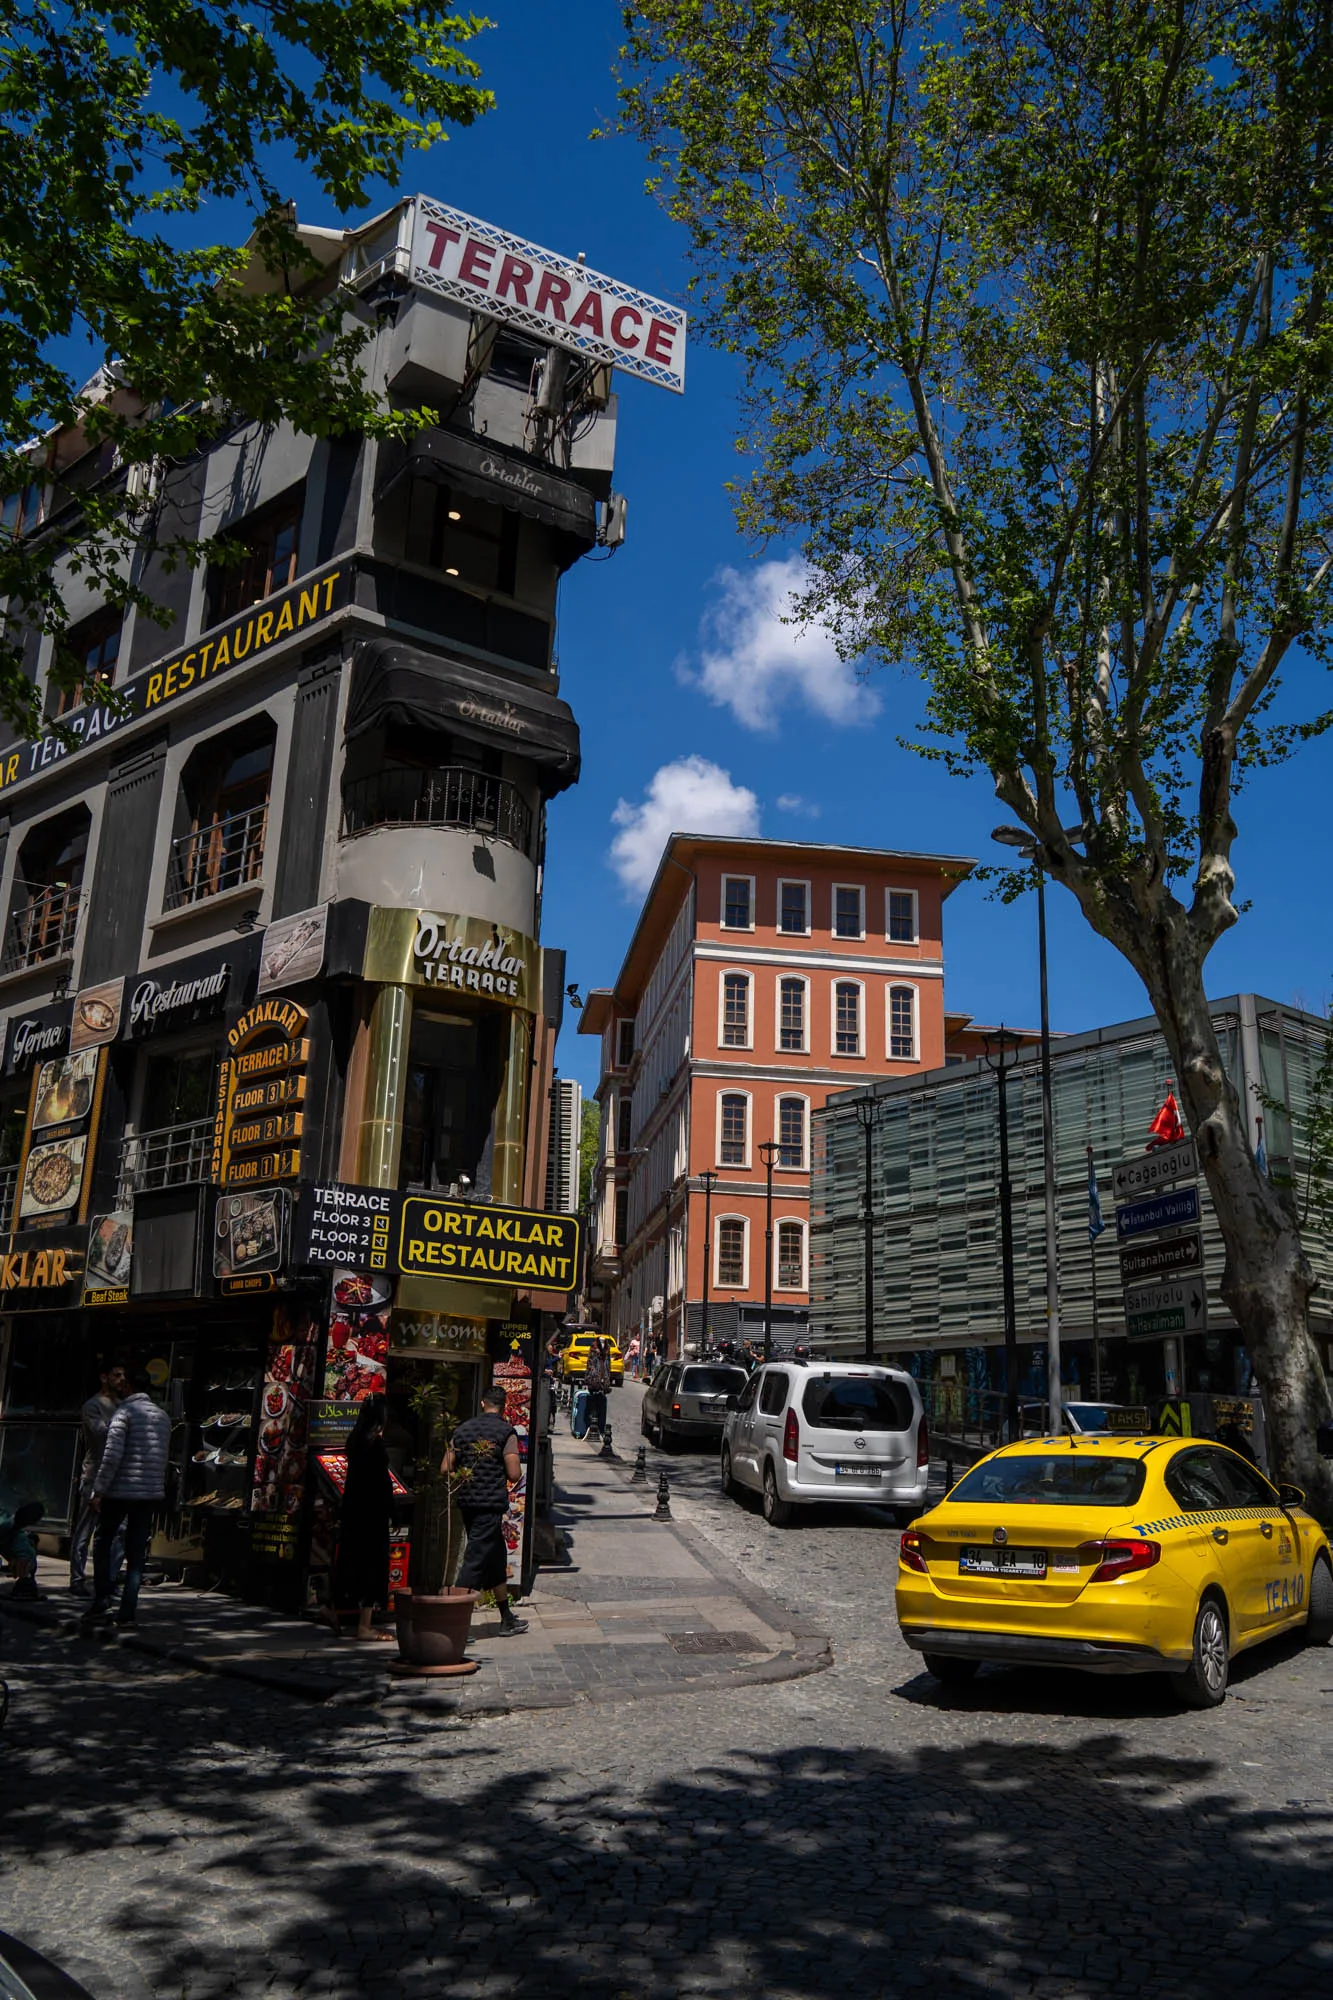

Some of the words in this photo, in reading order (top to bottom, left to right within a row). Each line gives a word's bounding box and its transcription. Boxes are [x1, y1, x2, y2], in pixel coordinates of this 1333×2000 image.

[426, 220, 677, 365] TERRACE
[480, 459, 543, 496] Ortaklar
[145, 572, 340, 708] RESTAURANT
[459, 701, 528, 734] Ortaklar
[414, 913, 527, 976] Ortaklar
[423, 961, 518, 997] TERRACE
[130, 963, 229, 1024] Restaurant
[228, 1001, 299, 1046] ORTAKLAR
[237, 1046, 283, 1075] TERRACE
[234, 1089, 264, 1109] FLOOR
[270, 1086, 276, 1101] 3
[211, 1062, 229, 1184] RESTAURANT
[231, 1124, 260, 1145] FLOOR
[266, 1122, 273, 1137] 2
[229, 1161, 258, 1181] FLOOR
[313, 1188, 390, 1211] TERRACE
[313, 1210, 360, 1226] FLOOR
[362, 1216, 371, 1227] 3
[423, 1209, 564, 1247] ORTAKLAR
[311, 1228, 358, 1244] FLOOR
[360, 1234, 369, 1246] 2
[309, 1247, 356, 1263] FLOOR
[359, 1253, 365, 1264] 1
[408, 1239, 571, 1279] RESTAURANT
[1123, 1247, 1185, 1271] Sultanahmet
[399, 1317, 487, 1340] welcome
[499, 1331, 532, 1340] FLOORS
[501, 1323, 528, 1331] UPPER
[968, 1550, 982, 1565] 34
[996, 1551, 1016, 1567] TEA
[1032, 1553, 1044, 1569] 10
